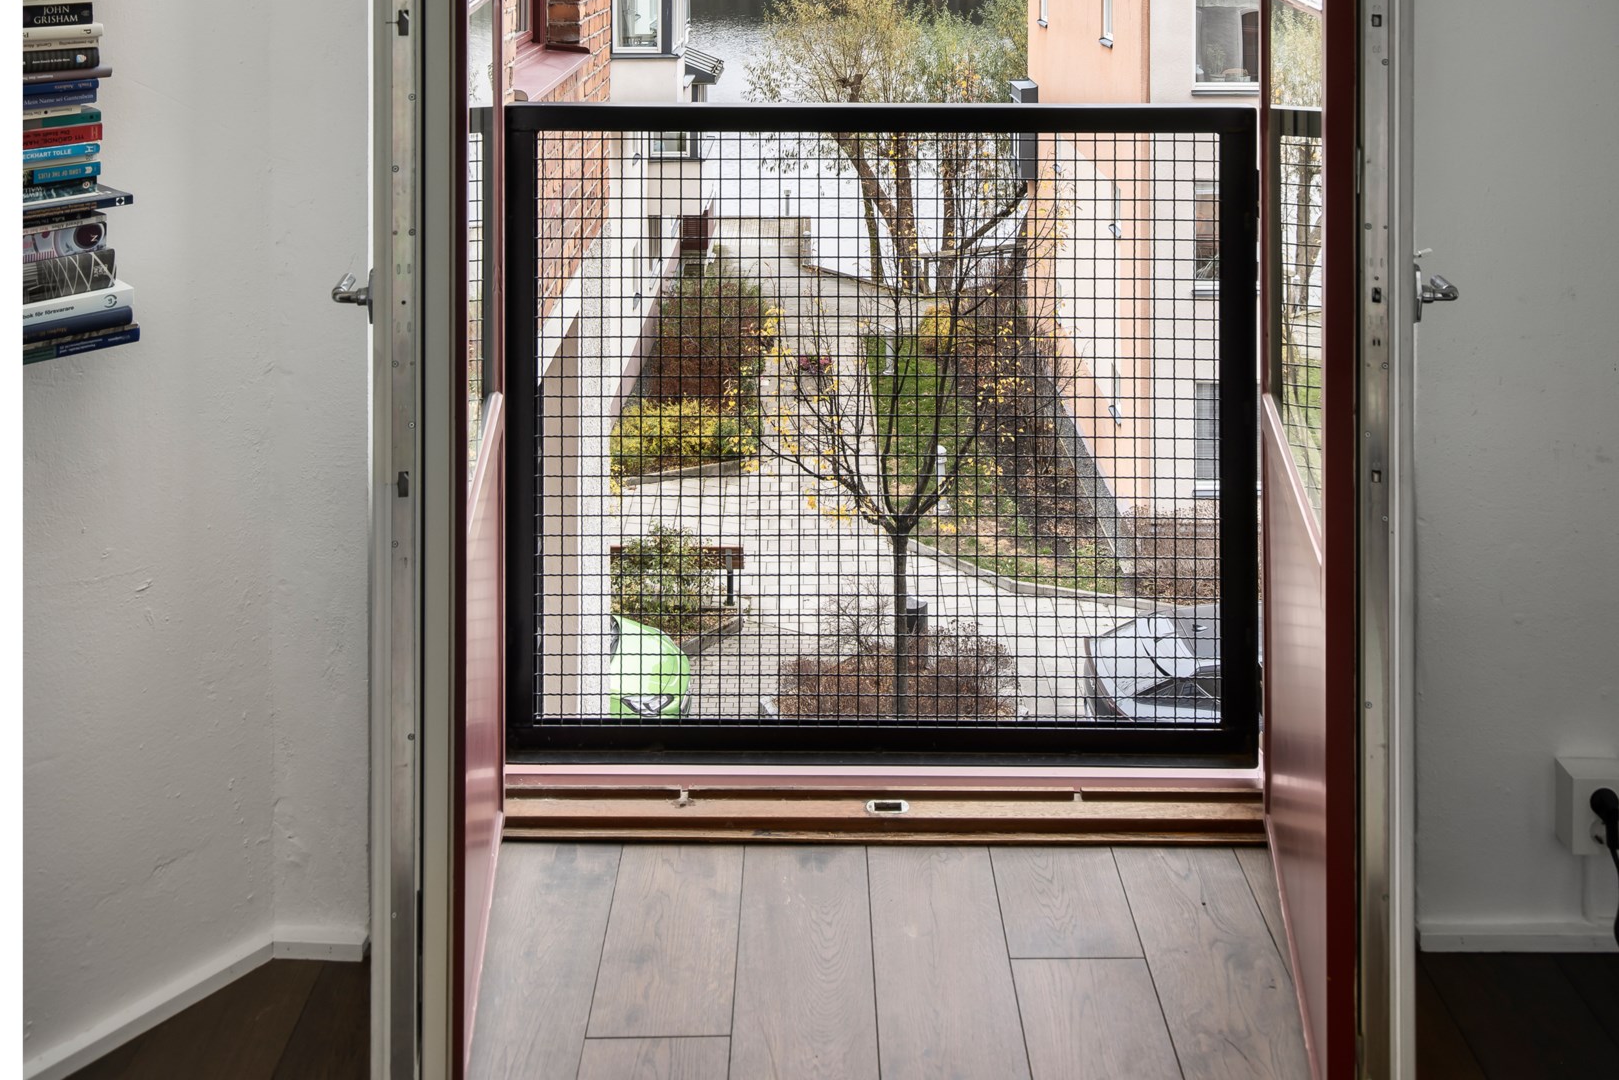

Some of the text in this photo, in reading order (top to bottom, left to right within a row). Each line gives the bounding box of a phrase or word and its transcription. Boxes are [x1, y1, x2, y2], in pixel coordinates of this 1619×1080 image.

[43, 5, 70, 15] JOHN
[33, 15, 79, 24] GRISHAM
[52, 148, 72, 157] TOLLE
[45, 306, 75, 316] försvarare
